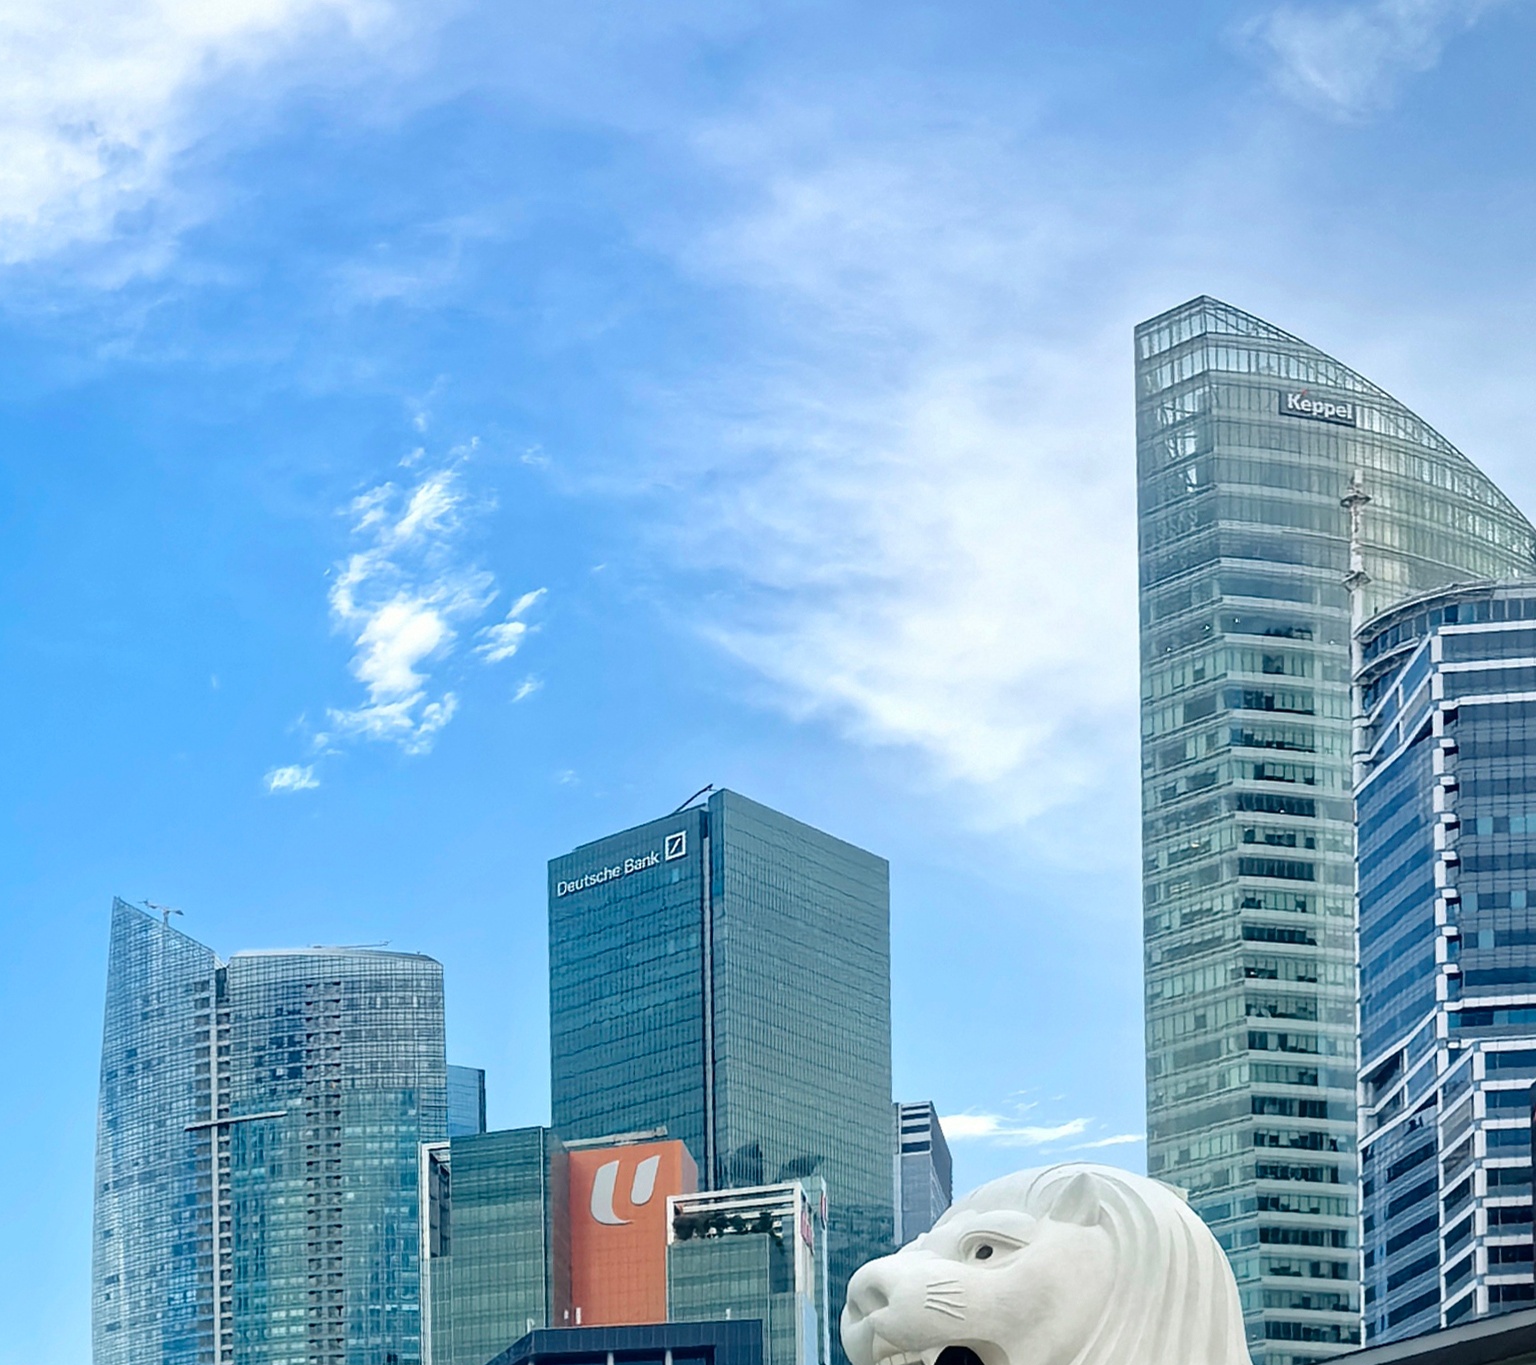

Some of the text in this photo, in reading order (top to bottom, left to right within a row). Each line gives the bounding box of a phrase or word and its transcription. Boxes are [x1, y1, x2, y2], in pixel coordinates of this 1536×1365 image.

[1287, 392, 1353, 419] Keppel
[557, 850, 660, 897] Deutsche Bank
